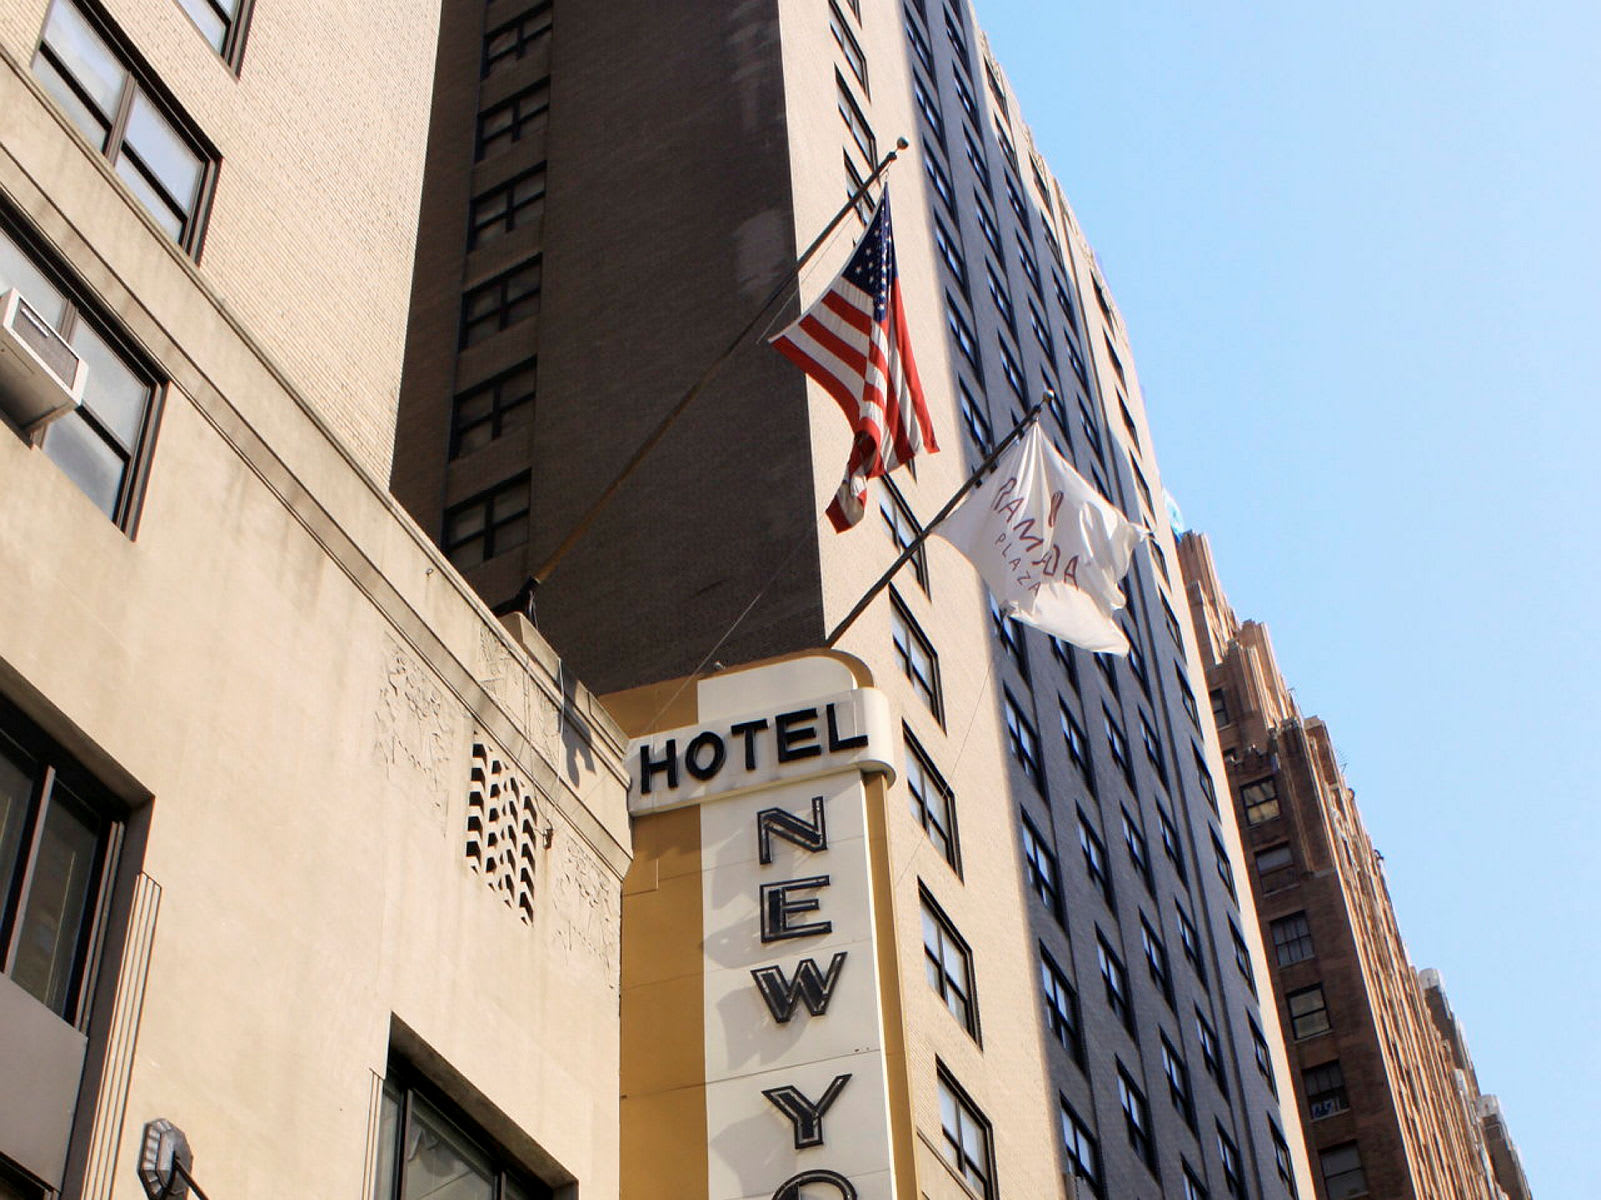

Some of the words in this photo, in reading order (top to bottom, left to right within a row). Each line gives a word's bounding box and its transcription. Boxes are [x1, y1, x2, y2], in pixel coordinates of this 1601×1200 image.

[994, 532, 1041, 597] PLAZA
[640, 703, 868, 794] HOTEL
[751, 796, 848, 1024] NEW
